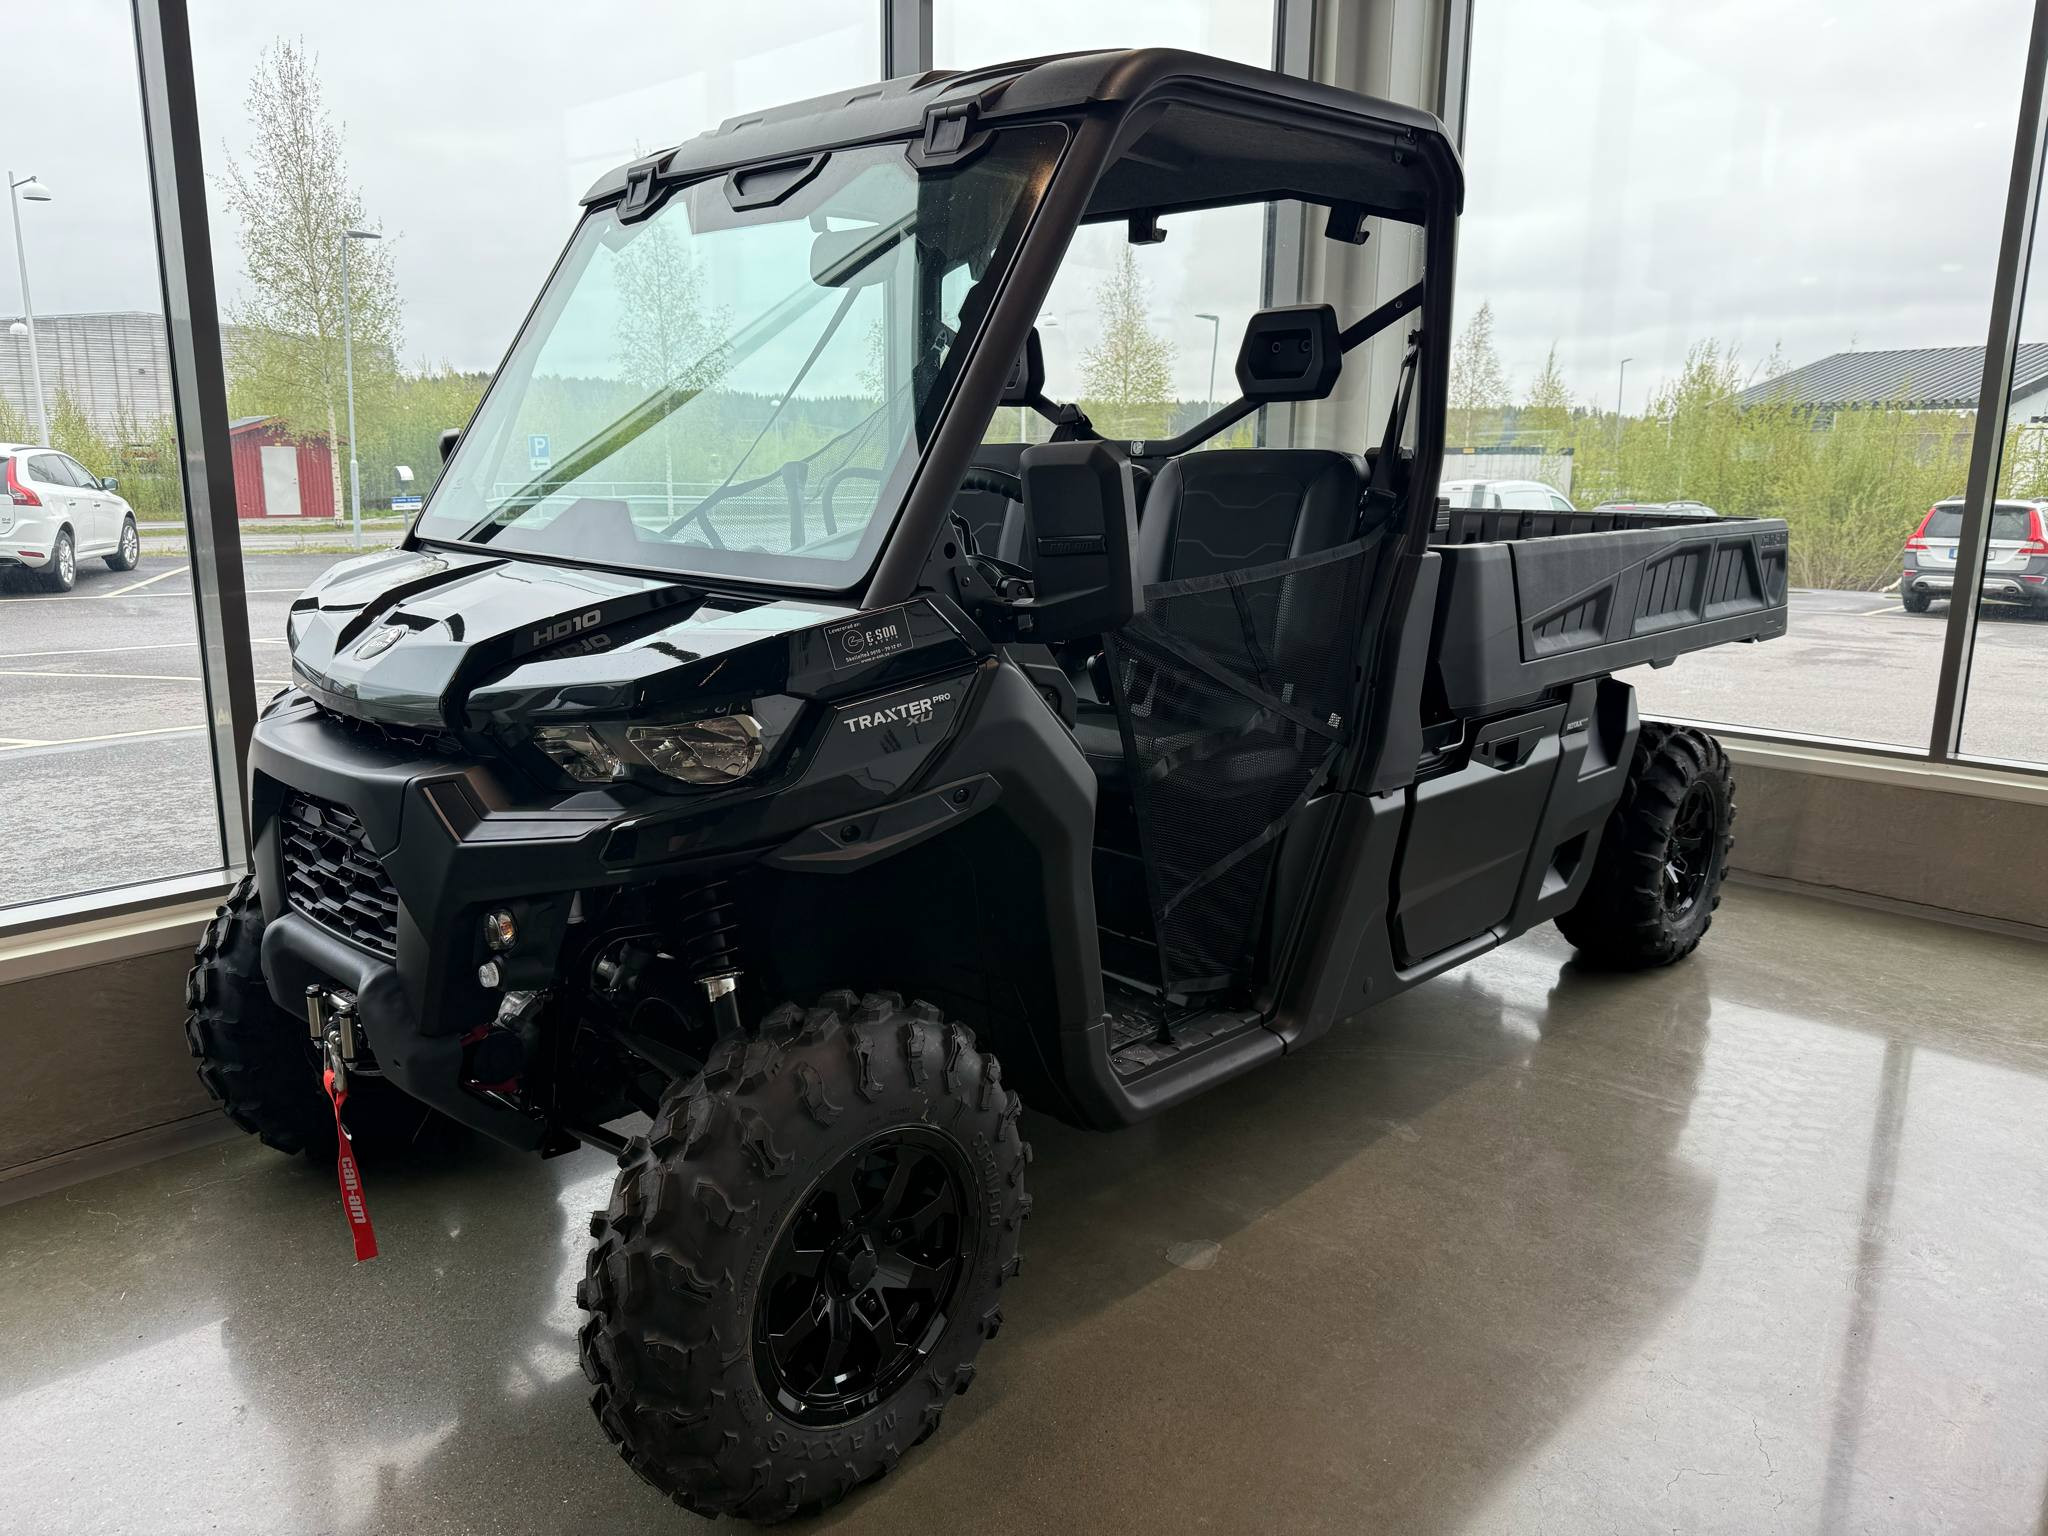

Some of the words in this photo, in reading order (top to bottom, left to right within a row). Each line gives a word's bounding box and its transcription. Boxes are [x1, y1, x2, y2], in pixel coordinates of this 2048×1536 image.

[534, 437, 546, 456] P
[533, 609, 601, 647] HD10
[843, 698, 933, 733] TRAXTER
[932, 692, 951, 704] PRO
[906, 711, 933, 727] XU
[341, 1156, 367, 1224] can-am
